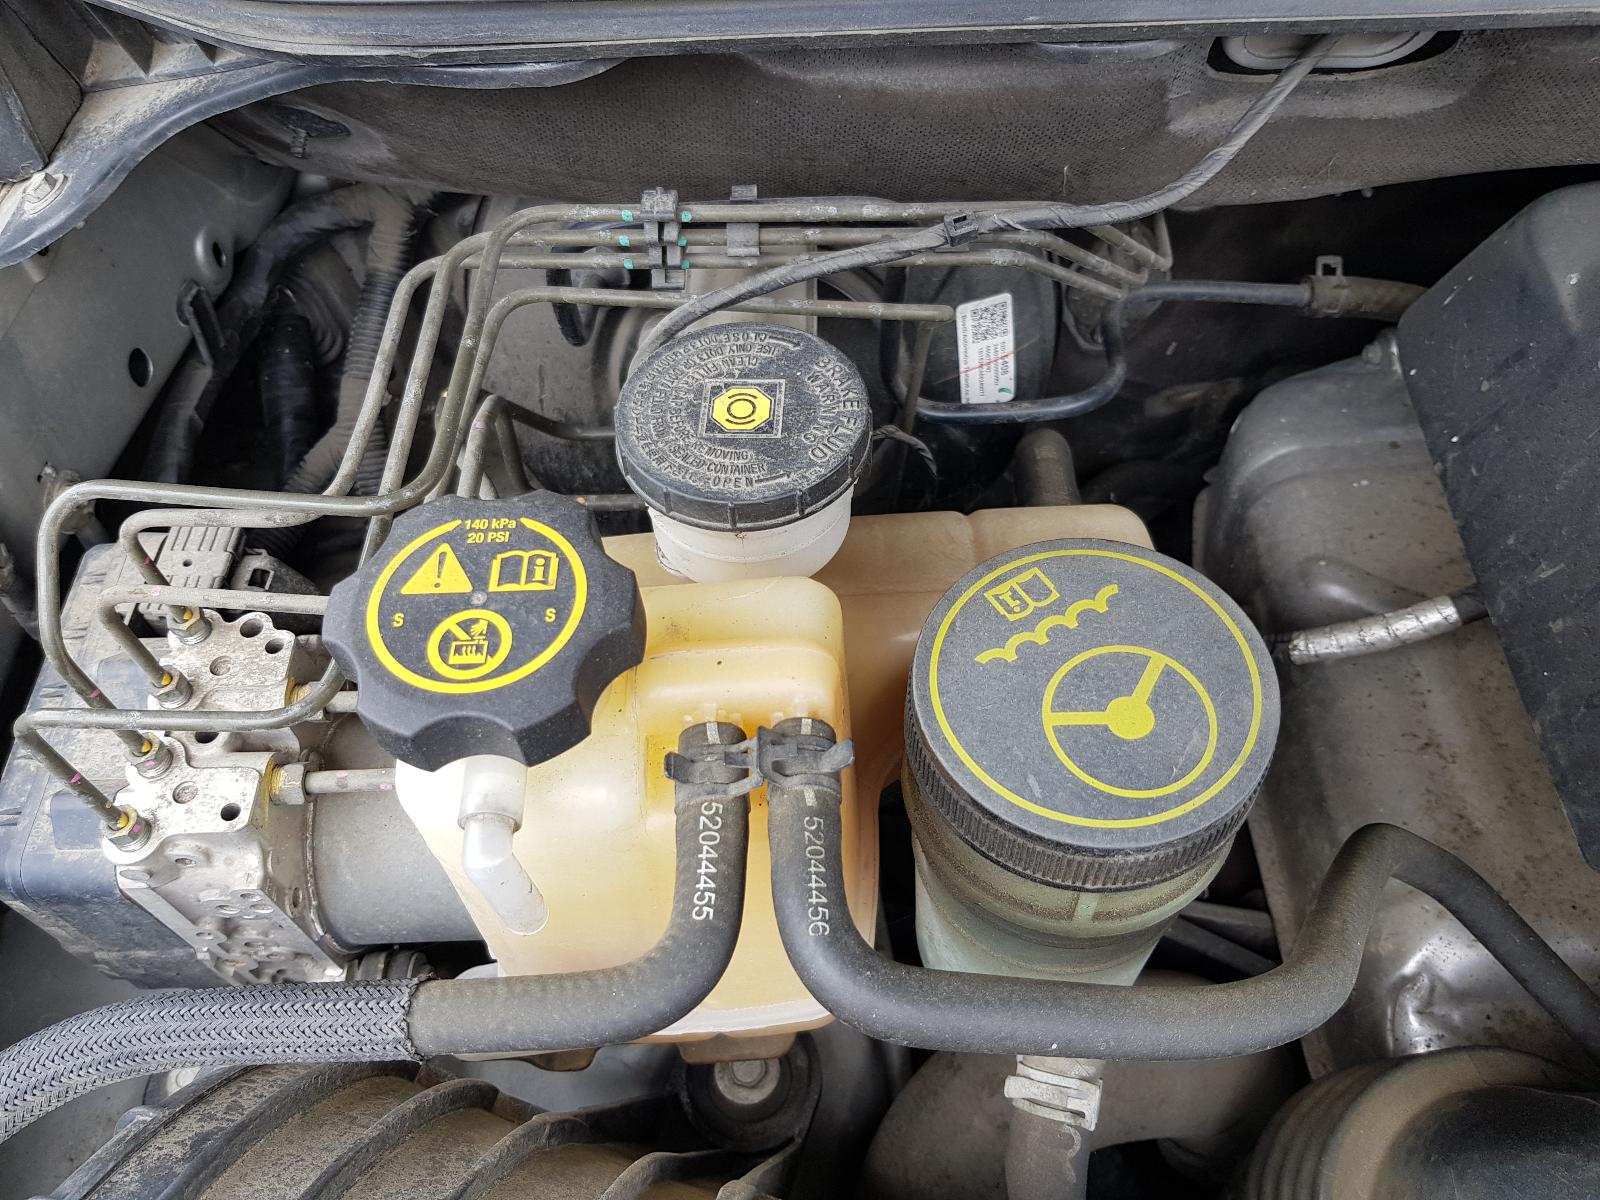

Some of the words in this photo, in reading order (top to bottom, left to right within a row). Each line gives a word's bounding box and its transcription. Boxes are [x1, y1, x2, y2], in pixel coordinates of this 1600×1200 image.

[721, 332, 767, 343] CLOSE
[726, 344, 751, 354] ONLY
[755, 344, 777, 356] USE
[719, 356, 758, 368] CLEAN
[815, 356, 859, 411] BRAKE
[803, 369, 837, 446] WARNING
[808, 414, 857, 463] FLUID
[704, 460, 767, 476] CONTAINER
[710, 474, 755, 488] OPEN
[464, 519, 489, 530] 140
[491, 518, 517, 530] kPa
[467, 533, 485, 544] 20
[487, 531, 510, 543] PSI
[692, 801, 723, 921] 52044455
[803, 816, 830, 937] 52044456
